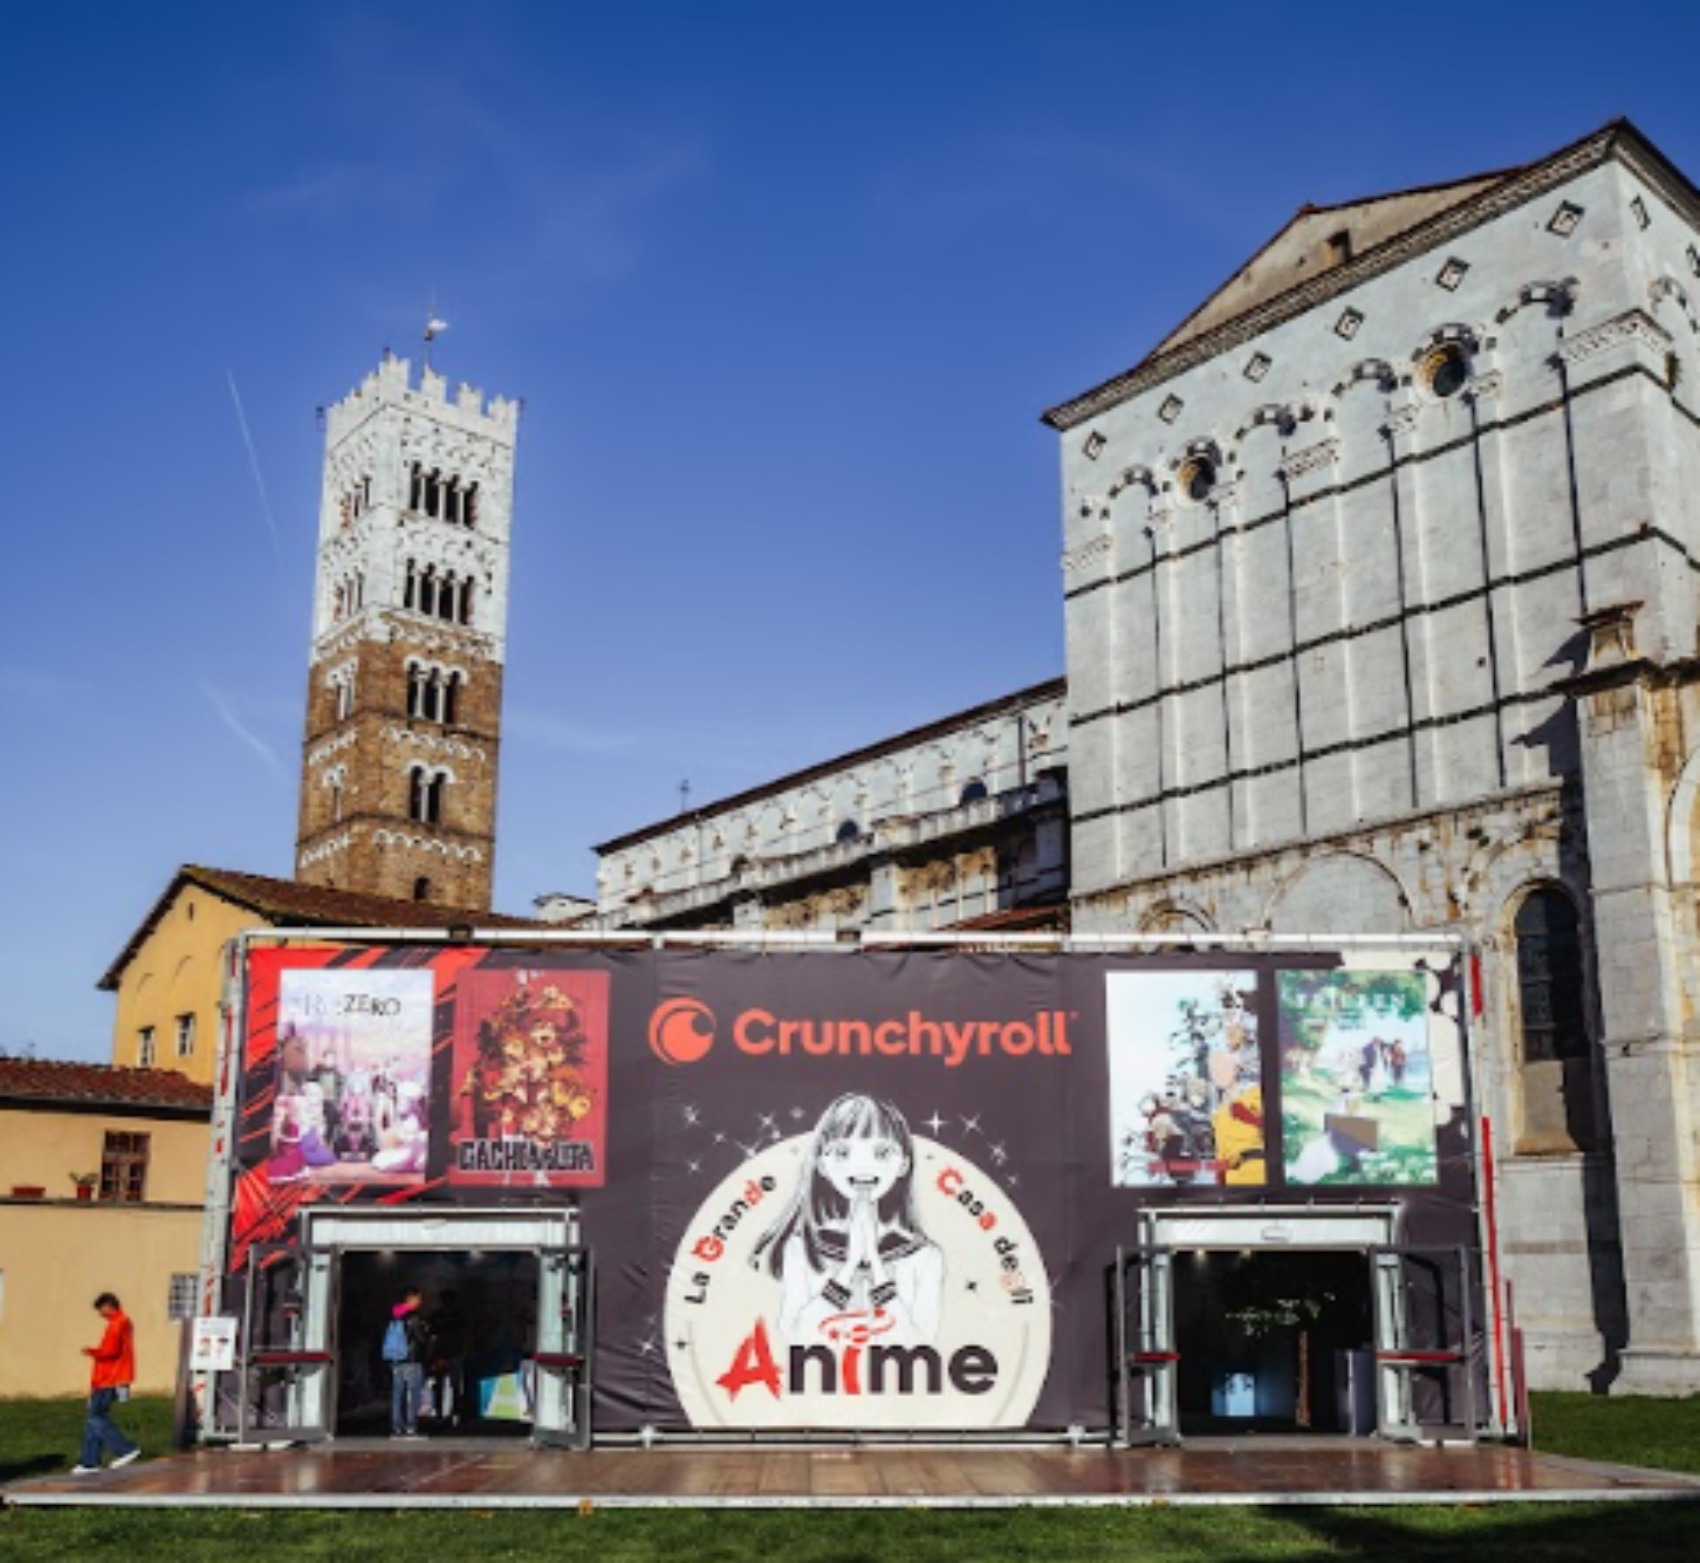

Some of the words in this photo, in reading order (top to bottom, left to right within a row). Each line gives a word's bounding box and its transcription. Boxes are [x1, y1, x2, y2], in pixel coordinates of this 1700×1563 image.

[734, 1009, 1072, 1066] Crunchyroll
[689, 1175, 777, 1262] Grande
[937, 1167, 996, 1231] Casa
[683, 1272, 710, 1304] La
[716, 1315, 999, 1402] Anime
